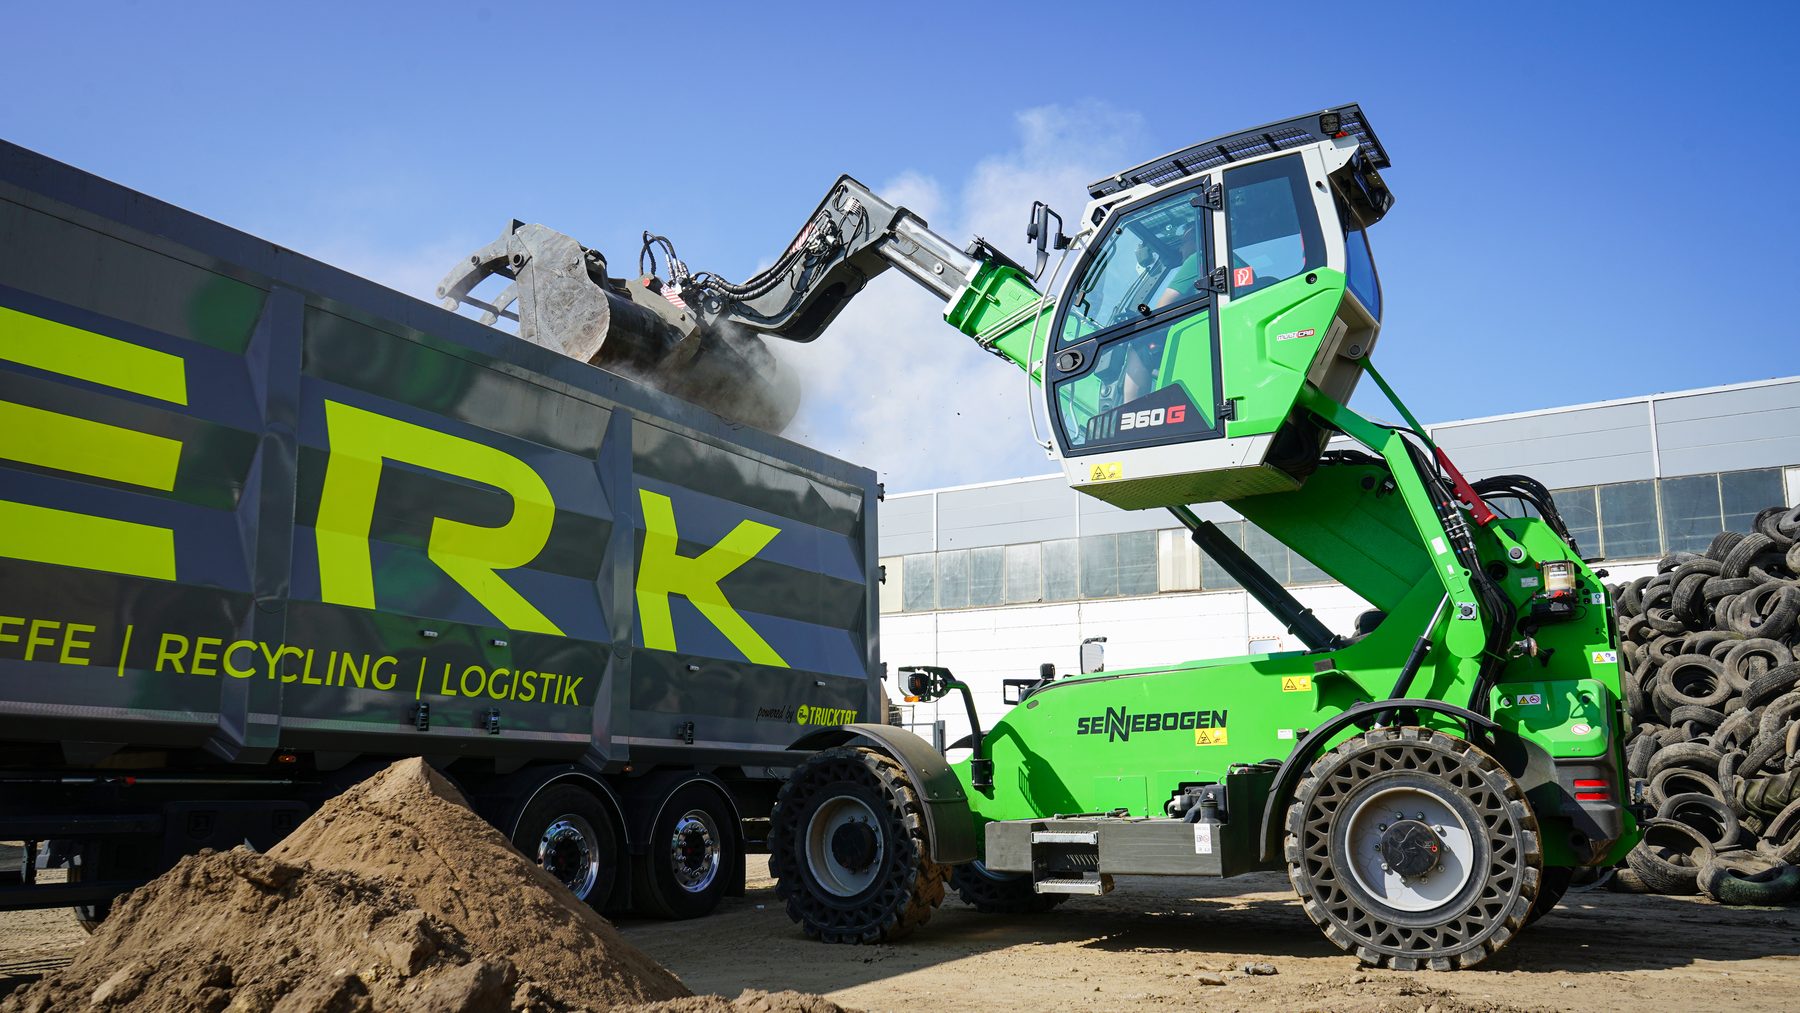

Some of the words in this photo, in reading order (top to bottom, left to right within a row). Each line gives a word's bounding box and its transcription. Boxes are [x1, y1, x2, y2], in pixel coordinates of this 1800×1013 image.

[1120, 404, 1186, 431] 360G
[155, 633, 398, 690] RECYCLING
[441, 663, 584, 704] LOGISTIK
[1077, 706, 1227, 742] SENNEBOGEN
